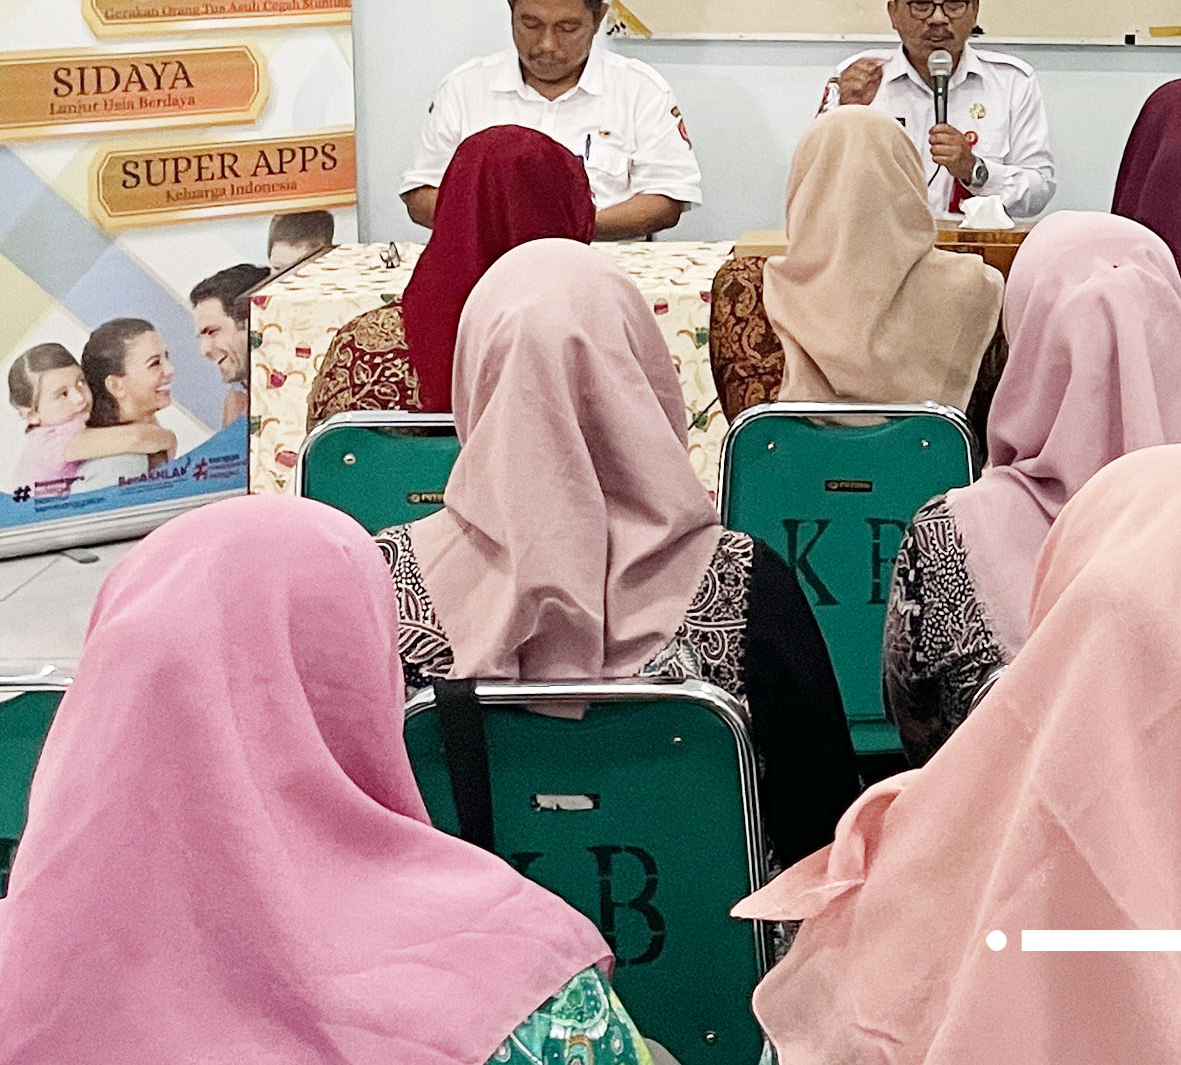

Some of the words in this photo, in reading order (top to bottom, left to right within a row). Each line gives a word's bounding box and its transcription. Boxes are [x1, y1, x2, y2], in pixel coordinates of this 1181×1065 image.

[104, 7, 159, 21] Gerakan
[161, 5, 200, 19] Orang
[229, 1, 260, 13] Asuh
[263, 0, 300, 13] Cegah
[52, 60, 195, 99] SIDAYA
[49, 101, 98, 117] Lanjut
[103, 99, 135, 113] Usia
[139, 95, 196, 112] Berdaya
[121, 152, 241, 190] SUPER
[249, 142, 338, 178] APPS
[165, 187, 227, 204] Keluarga
[230, 179, 298, 198] Indonesia
[781, 517, 842, 606] K
[586, 844, 666, 967] B
